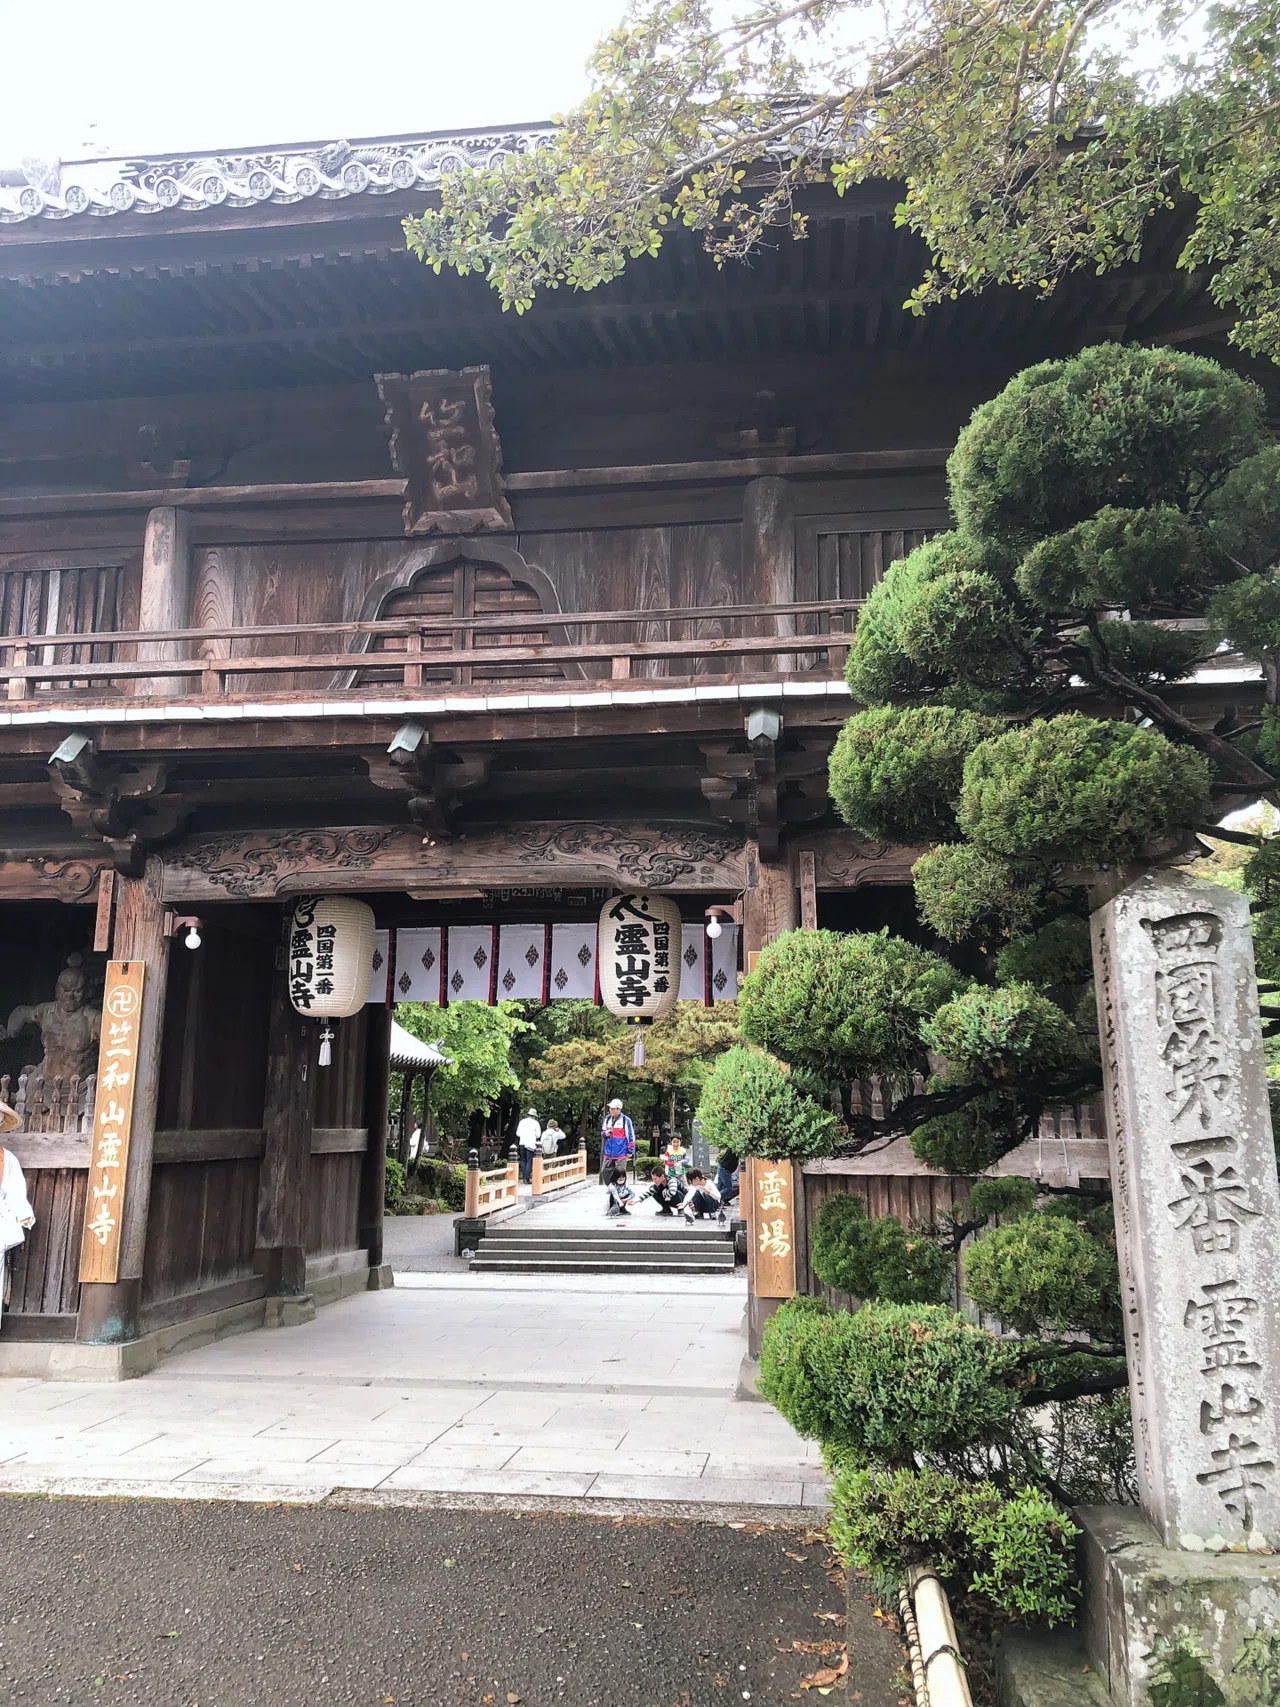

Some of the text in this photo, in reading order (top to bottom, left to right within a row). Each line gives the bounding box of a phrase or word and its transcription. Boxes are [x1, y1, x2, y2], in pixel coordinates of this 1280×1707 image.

[290, 928, 316, 1009] 霊山寺
[314, 924, 337, 995] 四国第一番
[614, 923, 652, 1008] 霊山寺
[653, 921, 671, 993] 四国第一番
